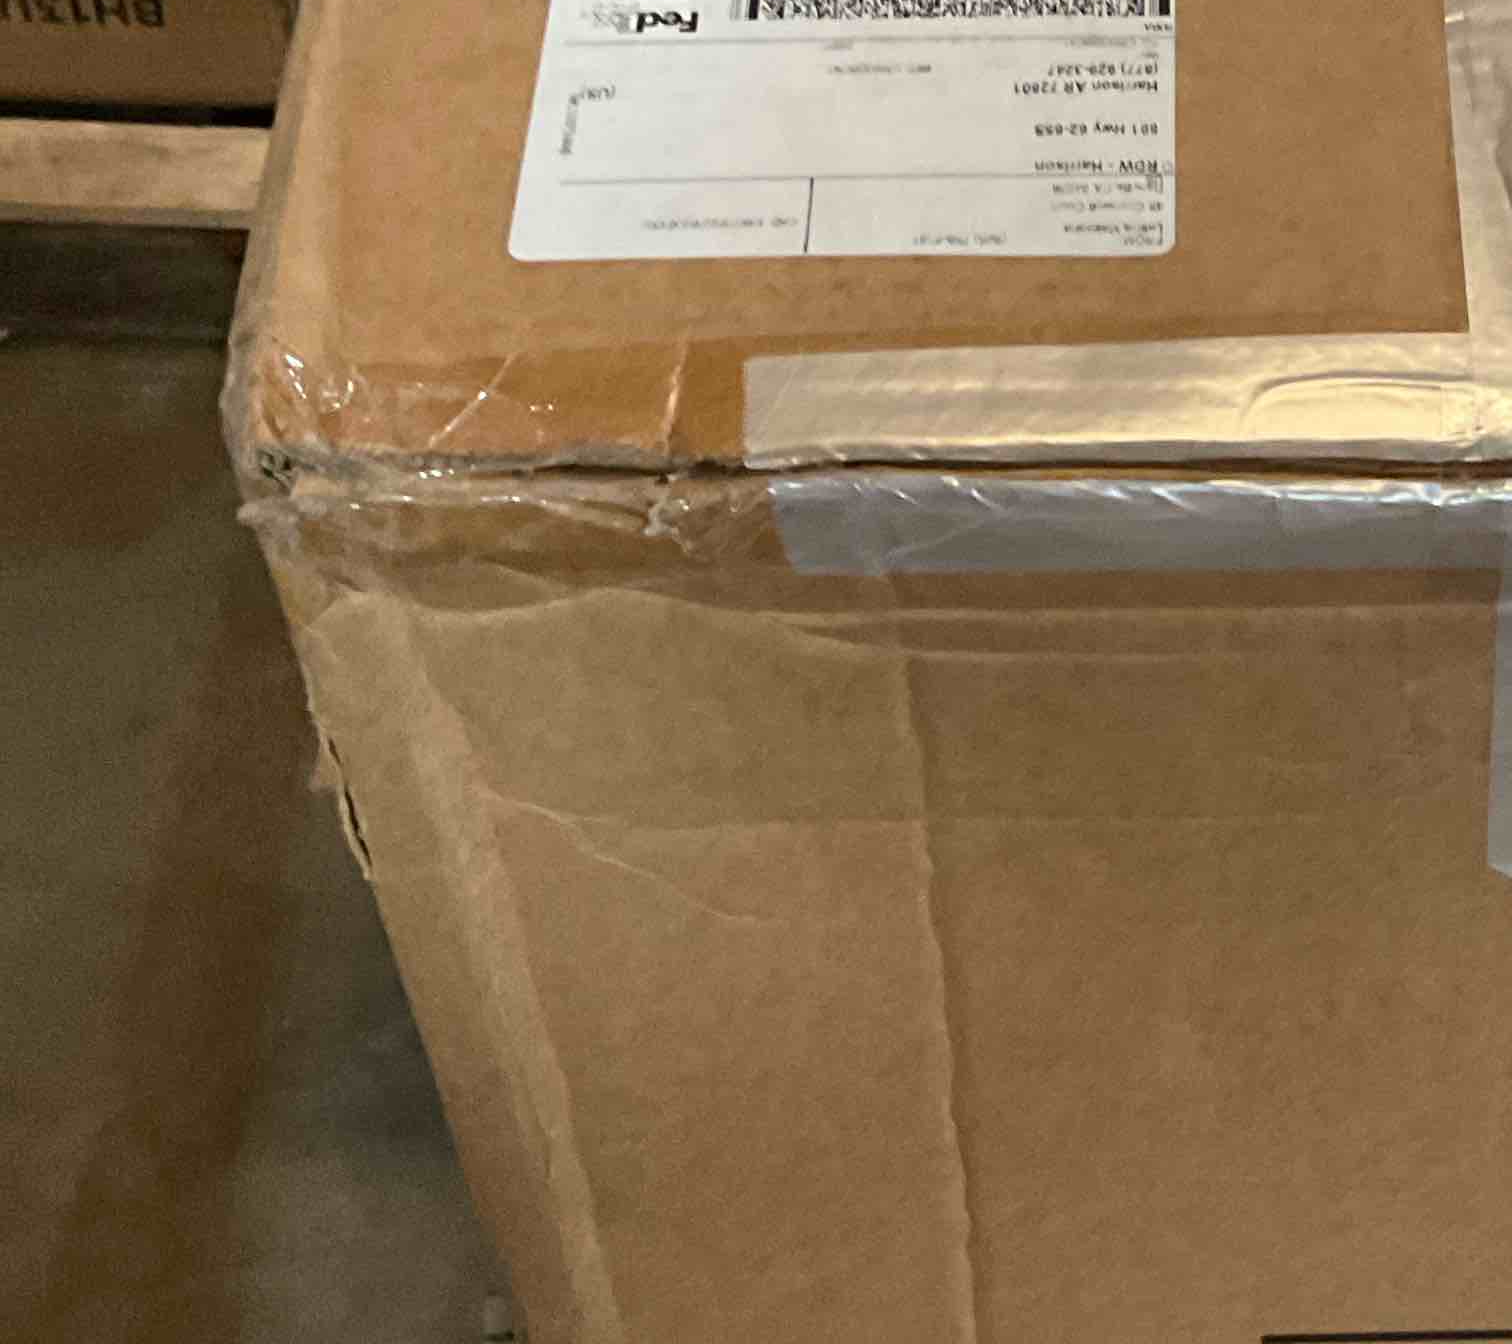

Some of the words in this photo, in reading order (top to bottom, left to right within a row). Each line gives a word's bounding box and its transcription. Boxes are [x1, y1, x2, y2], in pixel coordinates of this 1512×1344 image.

[1063, 81, 1088, 95] AR
[1092, 80, 1159, 94] Harrison
[1094, 123, 1126, 136] Hwy
[1033, 160, 1103, 173] Harrison
[1118, 160, 1159, 173] RDW
